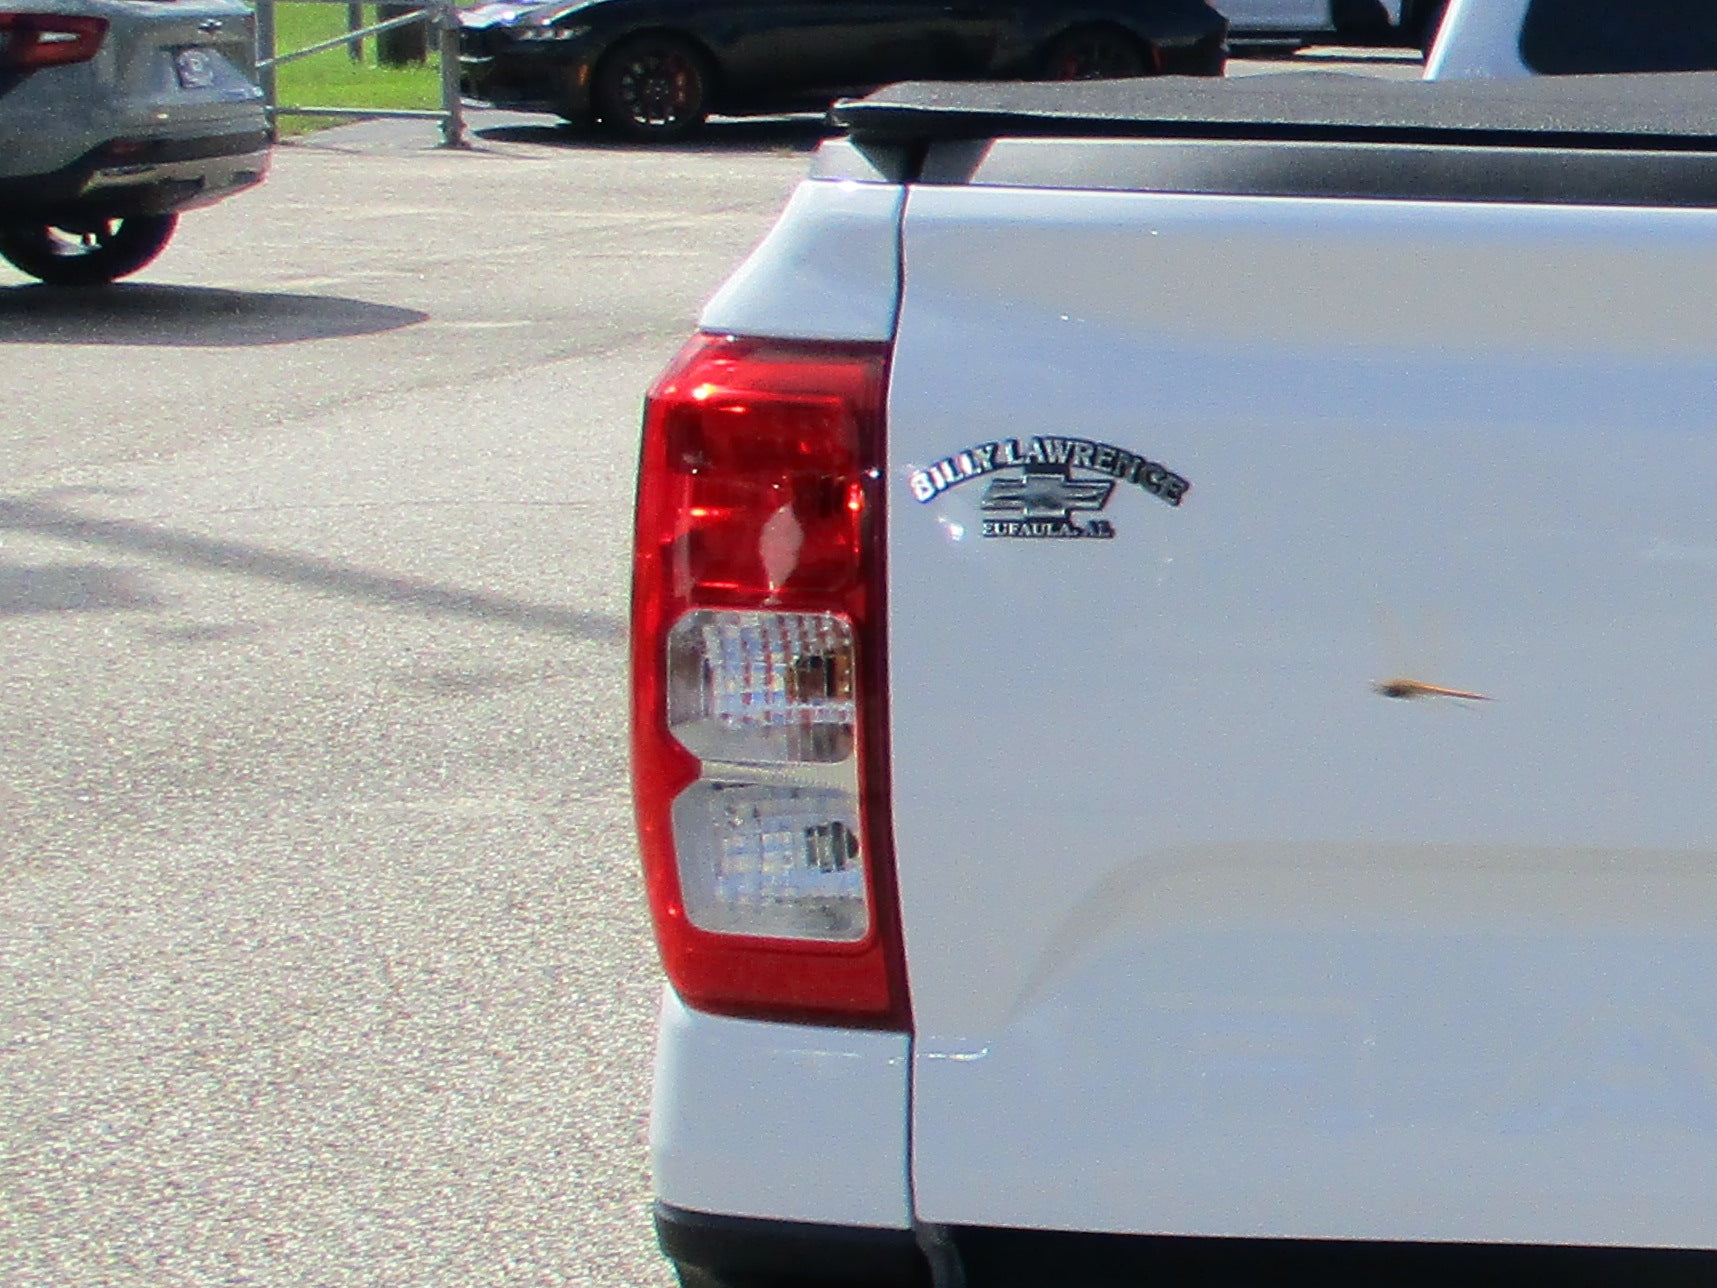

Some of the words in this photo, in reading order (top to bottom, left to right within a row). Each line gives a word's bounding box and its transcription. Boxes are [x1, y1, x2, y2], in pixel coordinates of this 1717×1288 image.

[909, 440, 1000, 503] BILLY
[1002, 435, 1190, 506] LAWRENCE
[1082, 519, 1116, 538] AL
